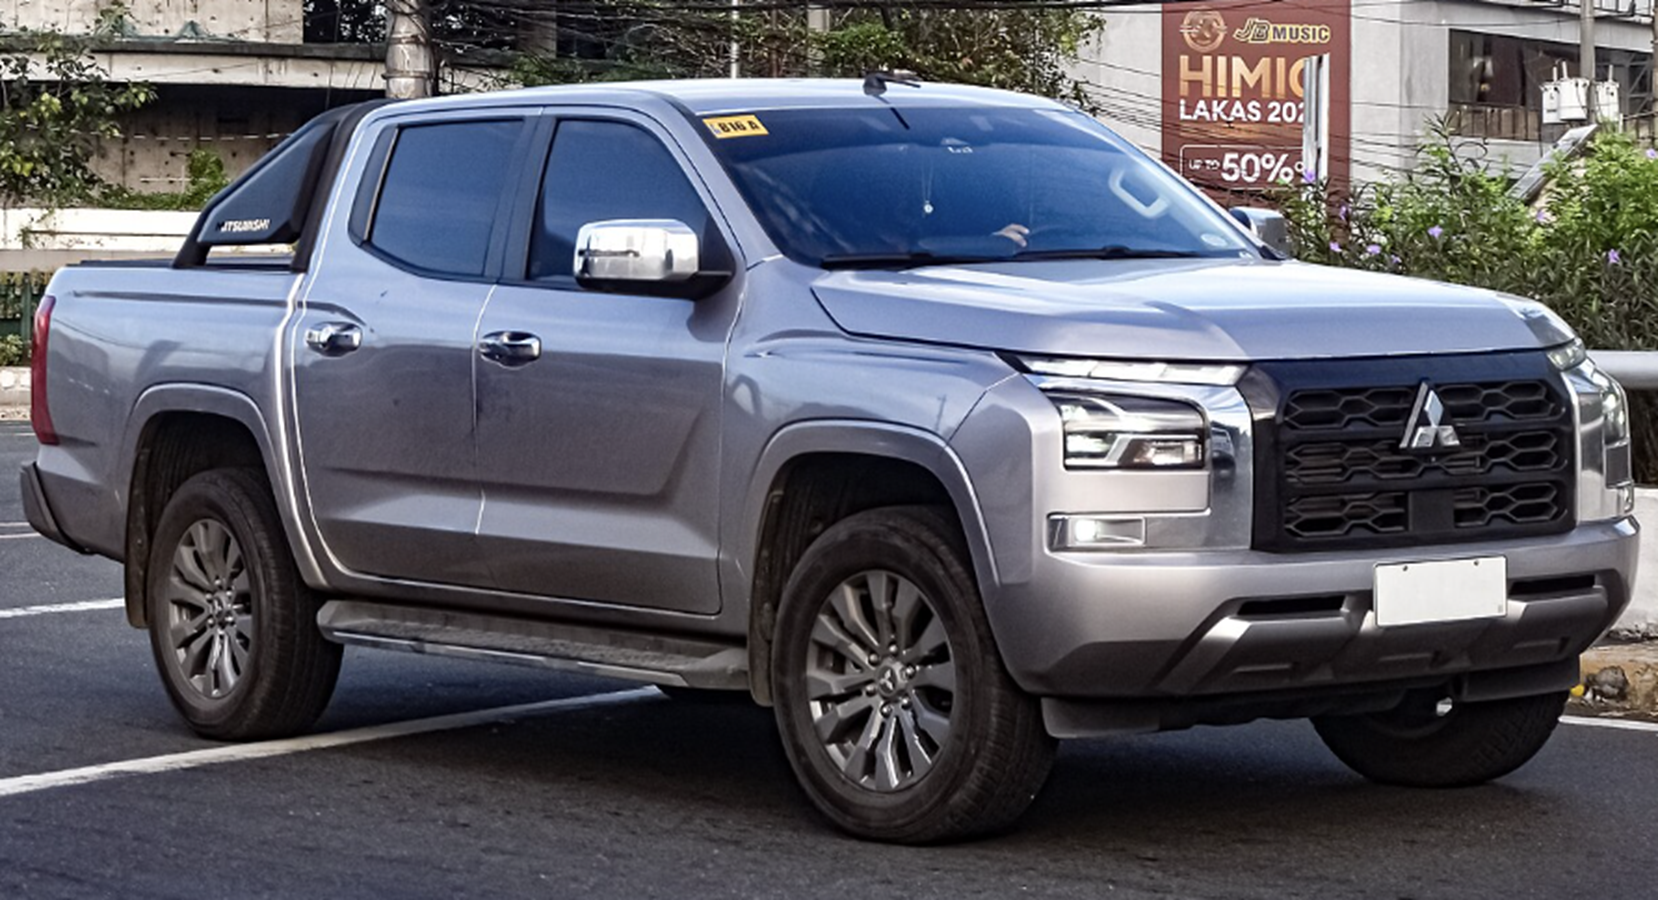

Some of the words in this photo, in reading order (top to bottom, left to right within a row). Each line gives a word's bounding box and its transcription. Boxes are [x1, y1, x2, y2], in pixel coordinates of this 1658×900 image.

[1271, 25, 1330, 42] MUSIC
[1179, 99, 1262, 122] LAKAS
[1188, 159, 1203, 170] UP
[1221, 152, 1295, 183] 50%
